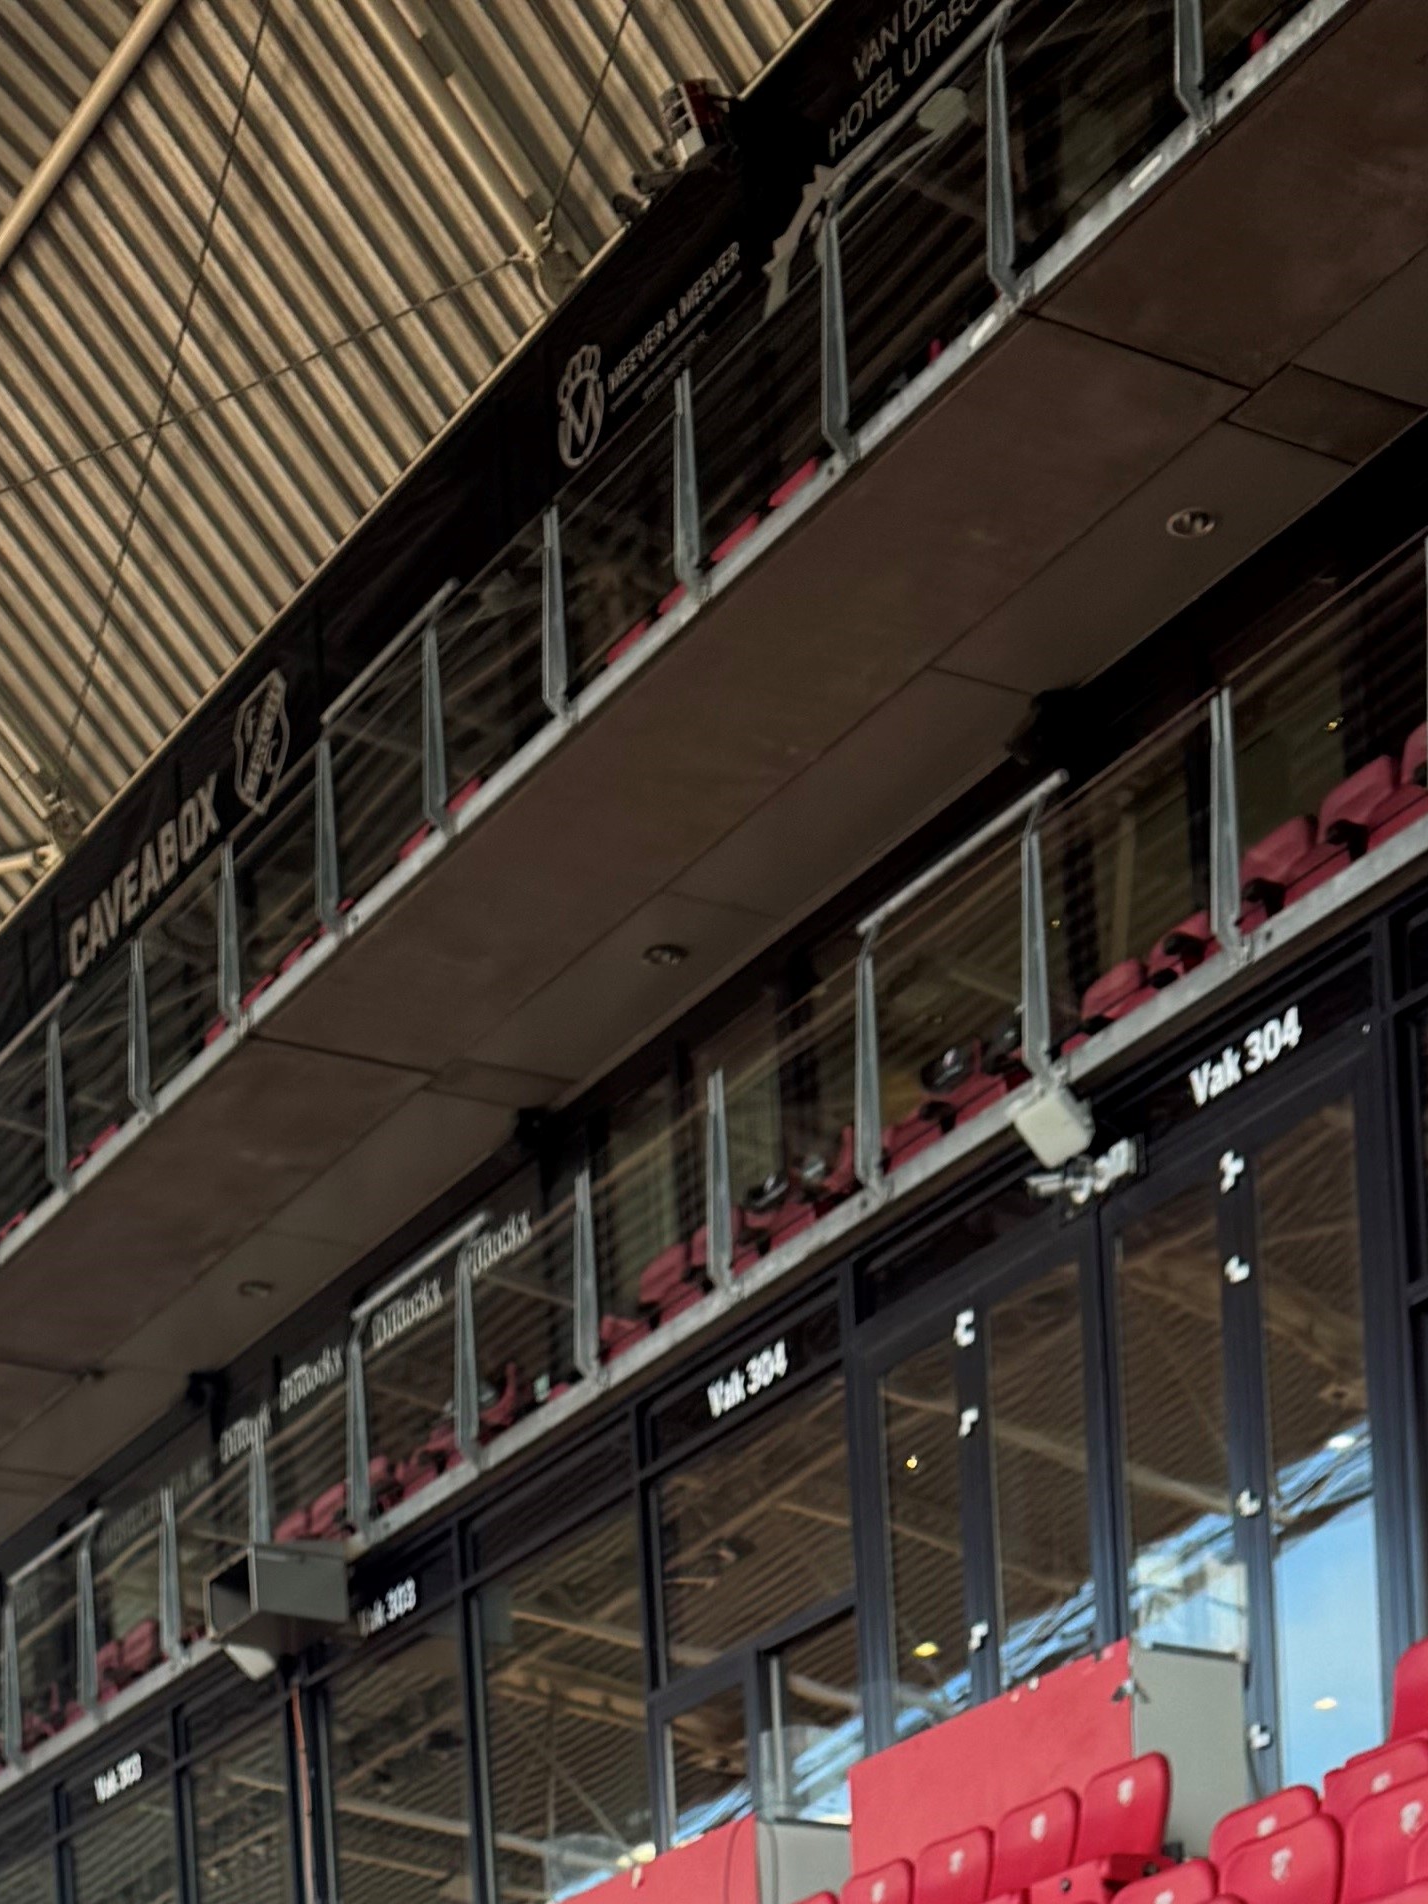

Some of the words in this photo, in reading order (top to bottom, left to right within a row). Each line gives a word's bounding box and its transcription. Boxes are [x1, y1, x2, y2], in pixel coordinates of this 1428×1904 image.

[852, 12, 900, 82] VAN
[828, 67, 901, 159] HOTEL
[69, 771, 221, 979] CAVEABOX
[1189, 1047, 1242, 1106] Vak
[1244, 1005, 1303, 1074] 304
